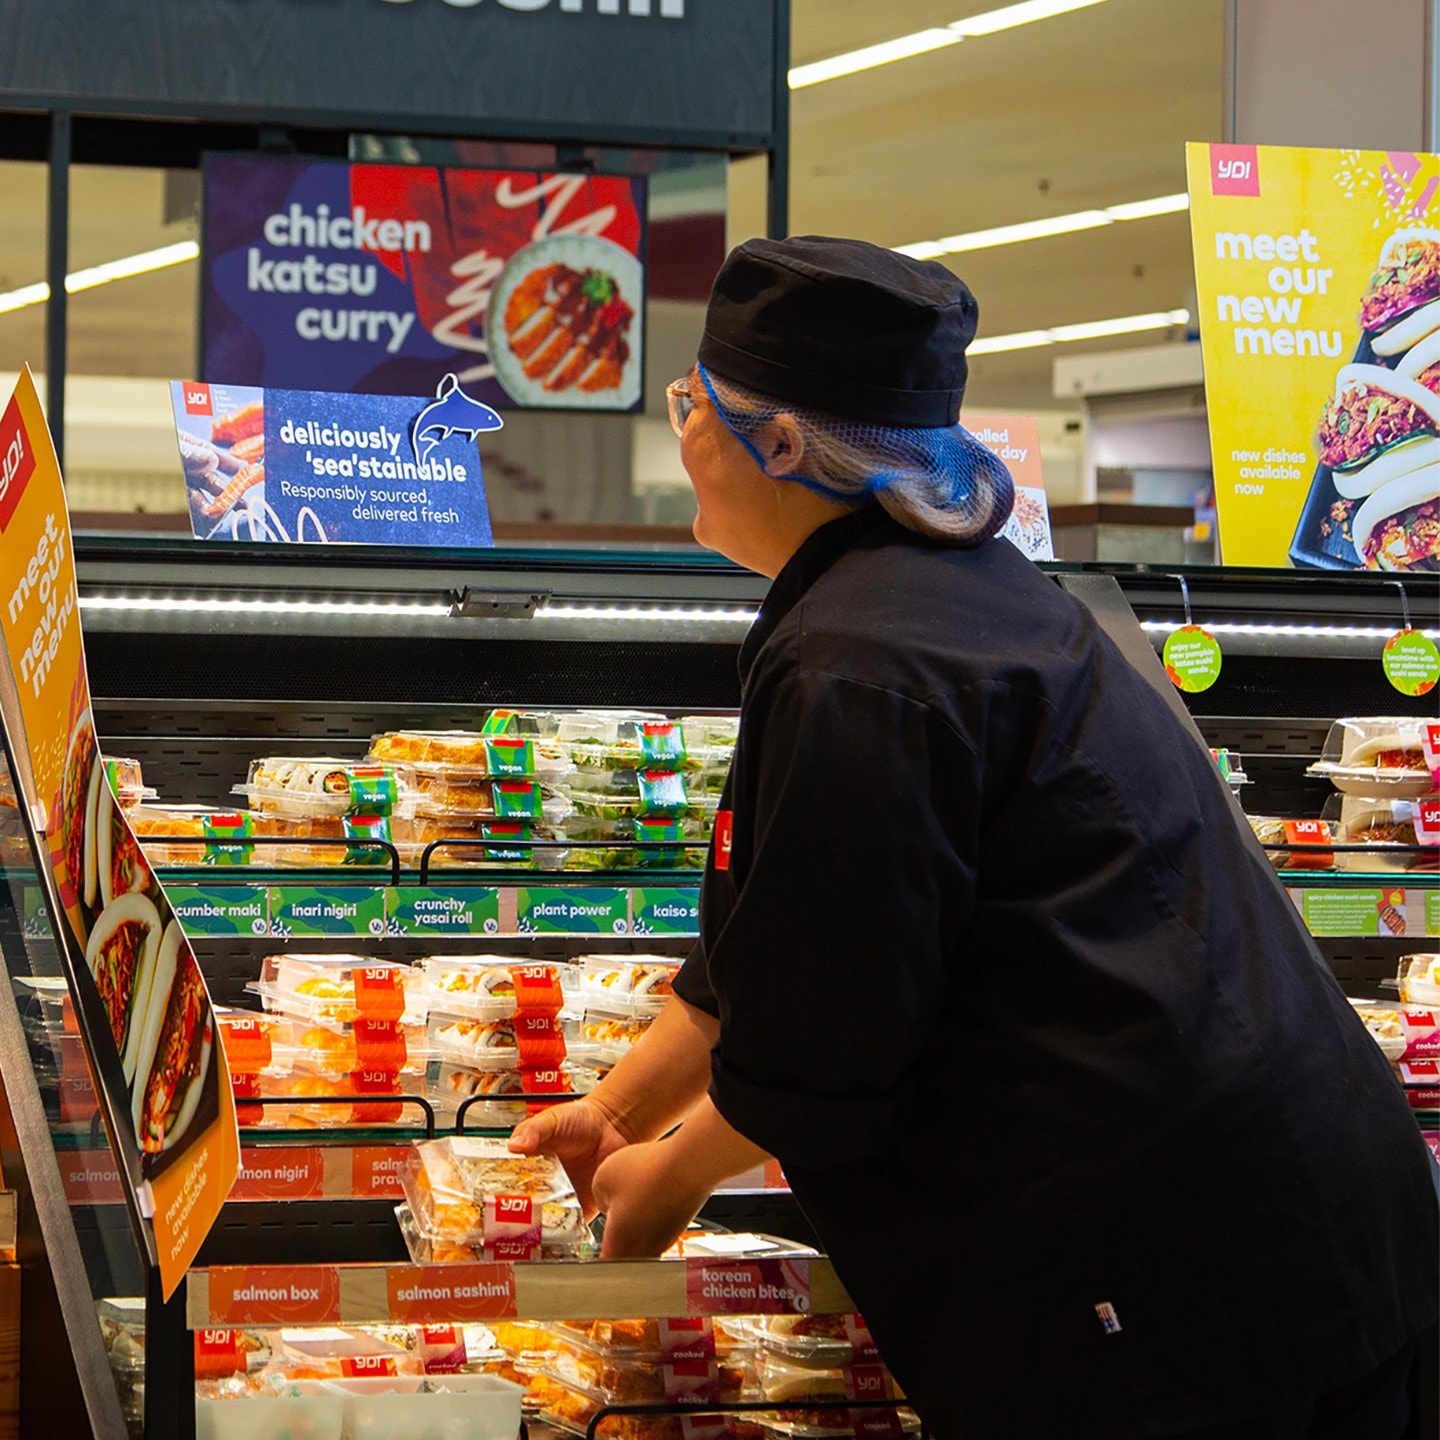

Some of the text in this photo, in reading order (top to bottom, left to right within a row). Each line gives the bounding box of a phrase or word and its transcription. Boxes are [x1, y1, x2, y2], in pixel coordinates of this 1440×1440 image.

[1217, 160, 1251, 180] YO!
[264, 204, 431, 252] chicken
[1215, 229, 1320, 263] meet
[248, 247, 377, 296] katsu
[1268, 267, 1333, 295] our
[1216, 294, 1303, 324] new
[295, 307, 415, 354] curry
[1235, 326, 1343, 357] menu
[187, 392, 208, 406] YO!
[280, 420, 401, 455] deliciously
[1001, 445, 1028, 463] day
[1231, 448, 1306, 464] new dishes
[1239, 465, 1301, 480] available
[281, 481, 432, 506] Responsibly sourced,
[1235, 484, 1265, 496] now
[352, 505, 460, 524] delivered fresh
[8, 513, 58, 624] meet
[40, 528, 65, 604] our
[20, 588, 58, 683] new
[32, 580, 75, 699] menu
[499, 764, 523, 773] vegan
[363, 793, 387, 801] vegan
[1296, 821, 1317, 832] YO!
[217, 844, 243, 852] vegan
[175, 903, 261, 917] cumber maki
[292, 903, 357, 919] inari nigiri
[414, 898, 466, 913] crunchy
[533, 903, 612, 918] plant power
[653, 904, 688, 917] kaiso
[414, 912, 472, 926] yasai roll
[365, 969, 389, 980] YO!
[523, 967, 546, 979] YO!
[367, 1020, 390, 1030] YO!
[527, 1018, 549, 1029] YO!
[363, 1071, 387, 1082] YO!
[535, 1071, 558, 1083] YO!
[239, 1166, 308, 1182] lmon nigiri
[166, 1148, 209, 1224] new dishes
[172, 1173, 208, 1236] available
[500, 1198, 527, 1212] YO!
[171, 1226, 189, 1261] now
[702, 1268, 751, 1282] korean
[233, 1285, 319, 1301] salmon box
[397, 1282, 510, 1301] salmon sashimi
[702, 1283, 794, 1299] chicken bites
[673, 1350, 704, 1359] cooked
[858, 1377, 881, 1389] YO!
